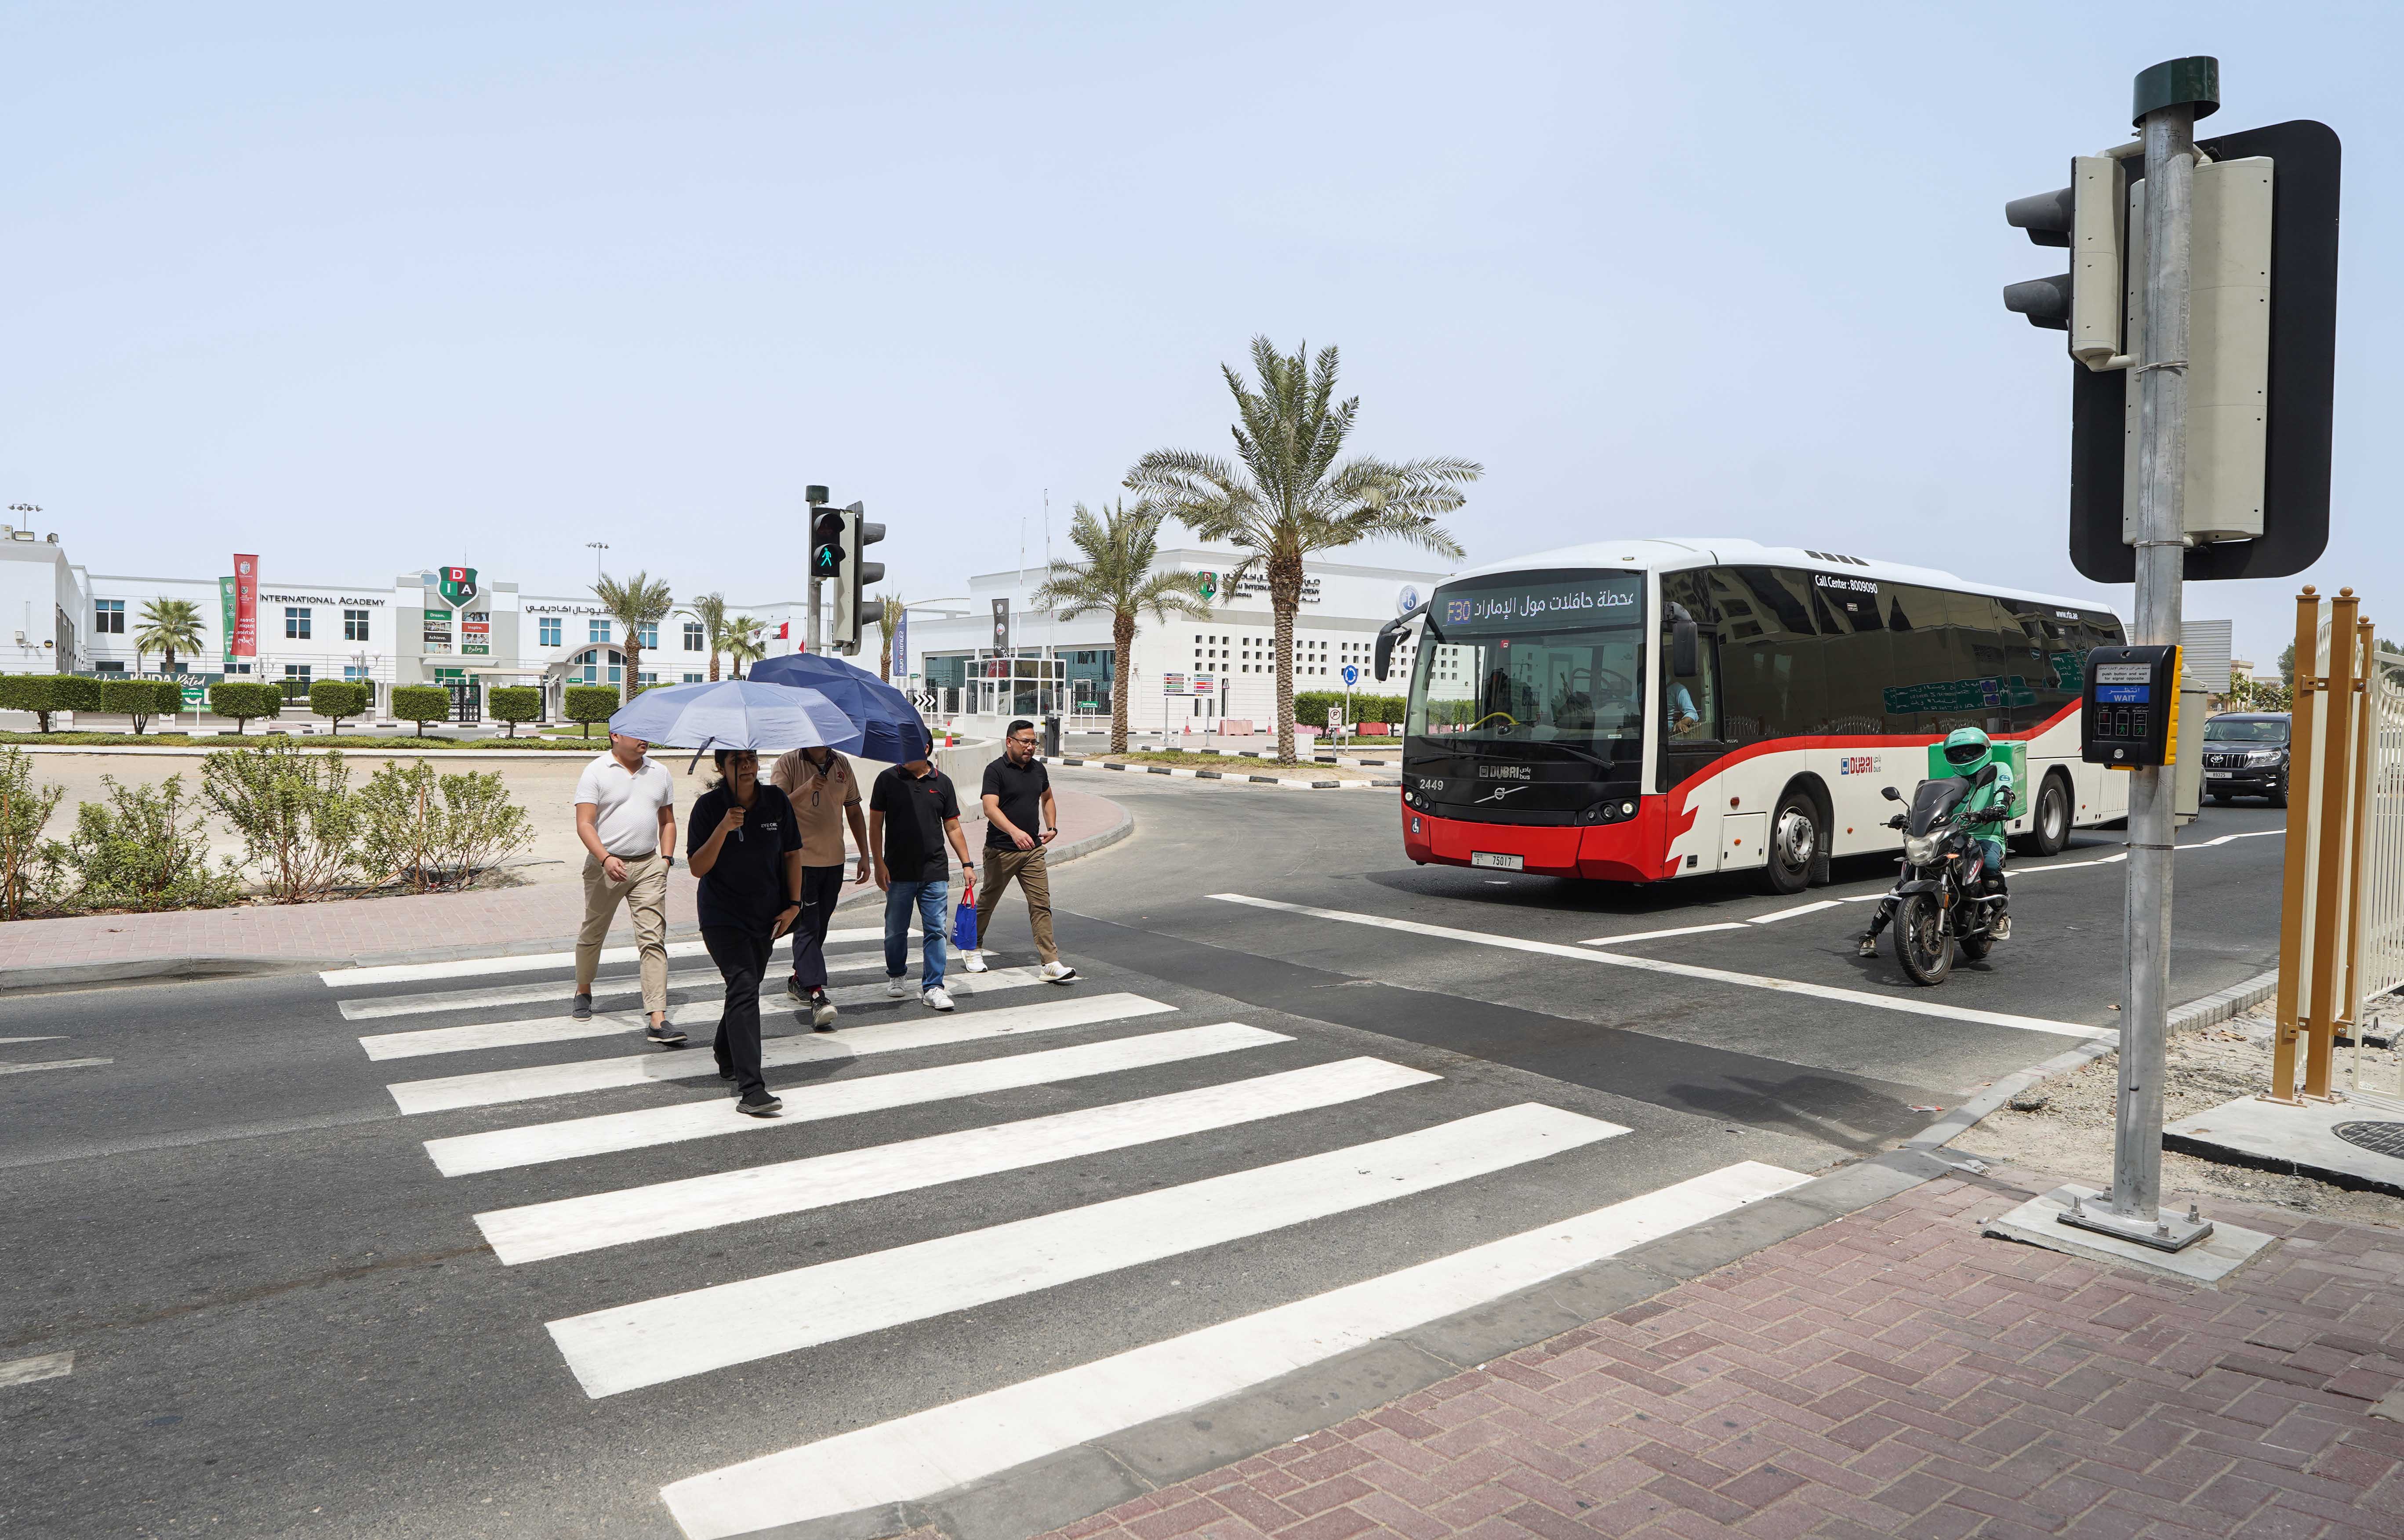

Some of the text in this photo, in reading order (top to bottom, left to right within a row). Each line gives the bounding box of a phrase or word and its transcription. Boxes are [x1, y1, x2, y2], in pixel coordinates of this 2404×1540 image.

[1815, 575, 1828, 587] Call
[1827, 576, 1847, 589] Center
[1850, 580, 1877, 594] 8009090
[339, 597, 385, 606] ACADEMY
[1520, 595, 1545, 616] مول
[1550, 592, 1594, 610] حافلات
[1448, 601, 1470, 621] F30
[176, 674, 206, 687] Rated
[1420, 779, 1444, 790] 2449
[1493, 856, 1511, 866] 75017
